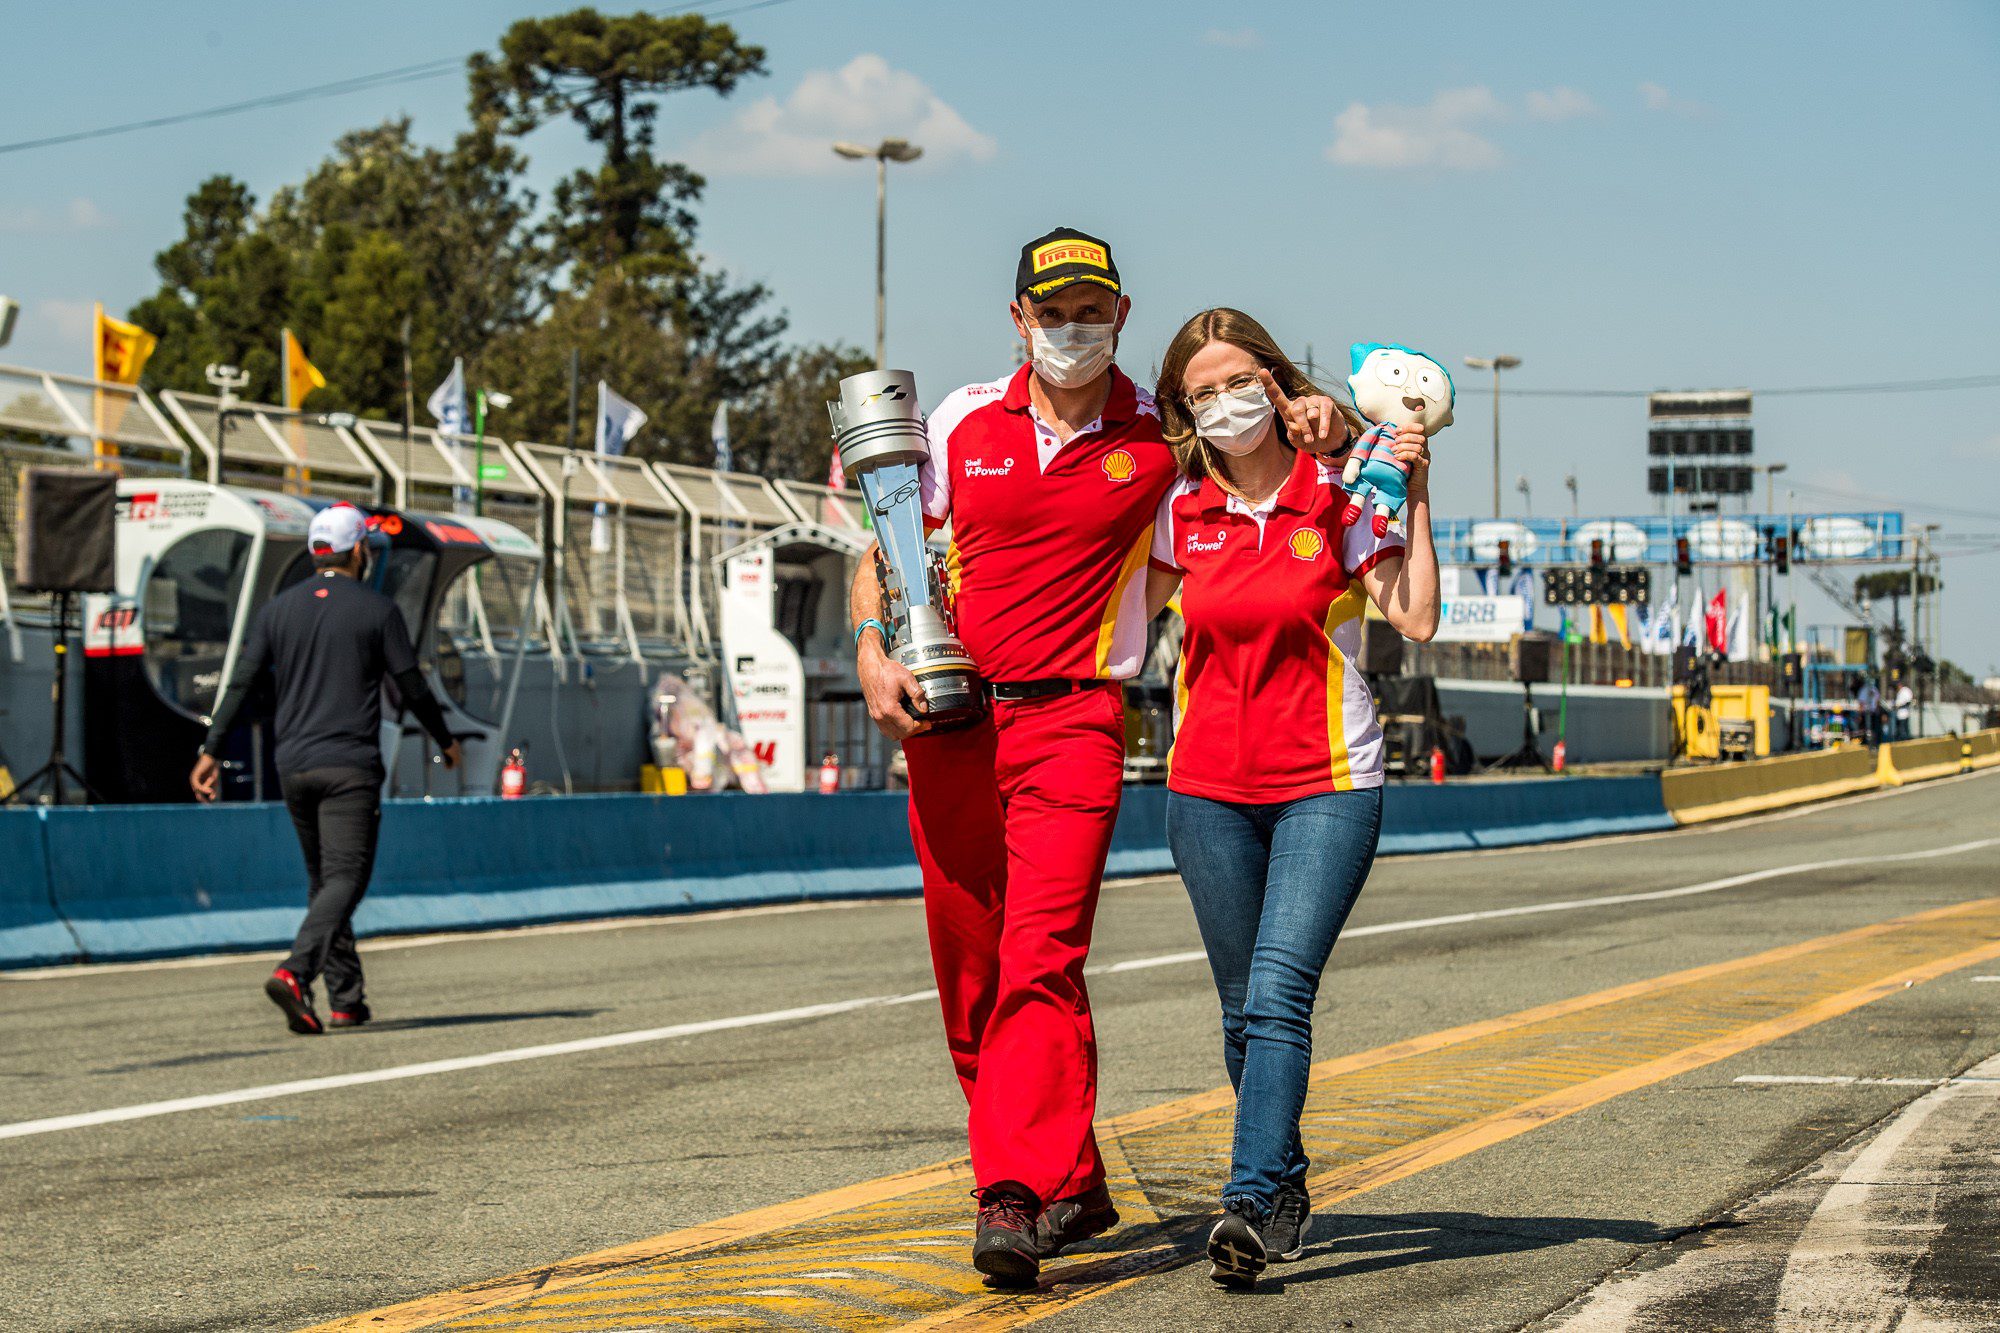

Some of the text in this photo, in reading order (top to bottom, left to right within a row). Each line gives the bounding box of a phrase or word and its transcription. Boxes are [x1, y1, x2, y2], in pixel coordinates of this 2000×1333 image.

[1038, 245, 1102, 267] PIRELLI
[964, 458, 982, 467] Shell
[964, 466, 1010, 478] V-Power
[1452, 602, 1495, 624] BRB
